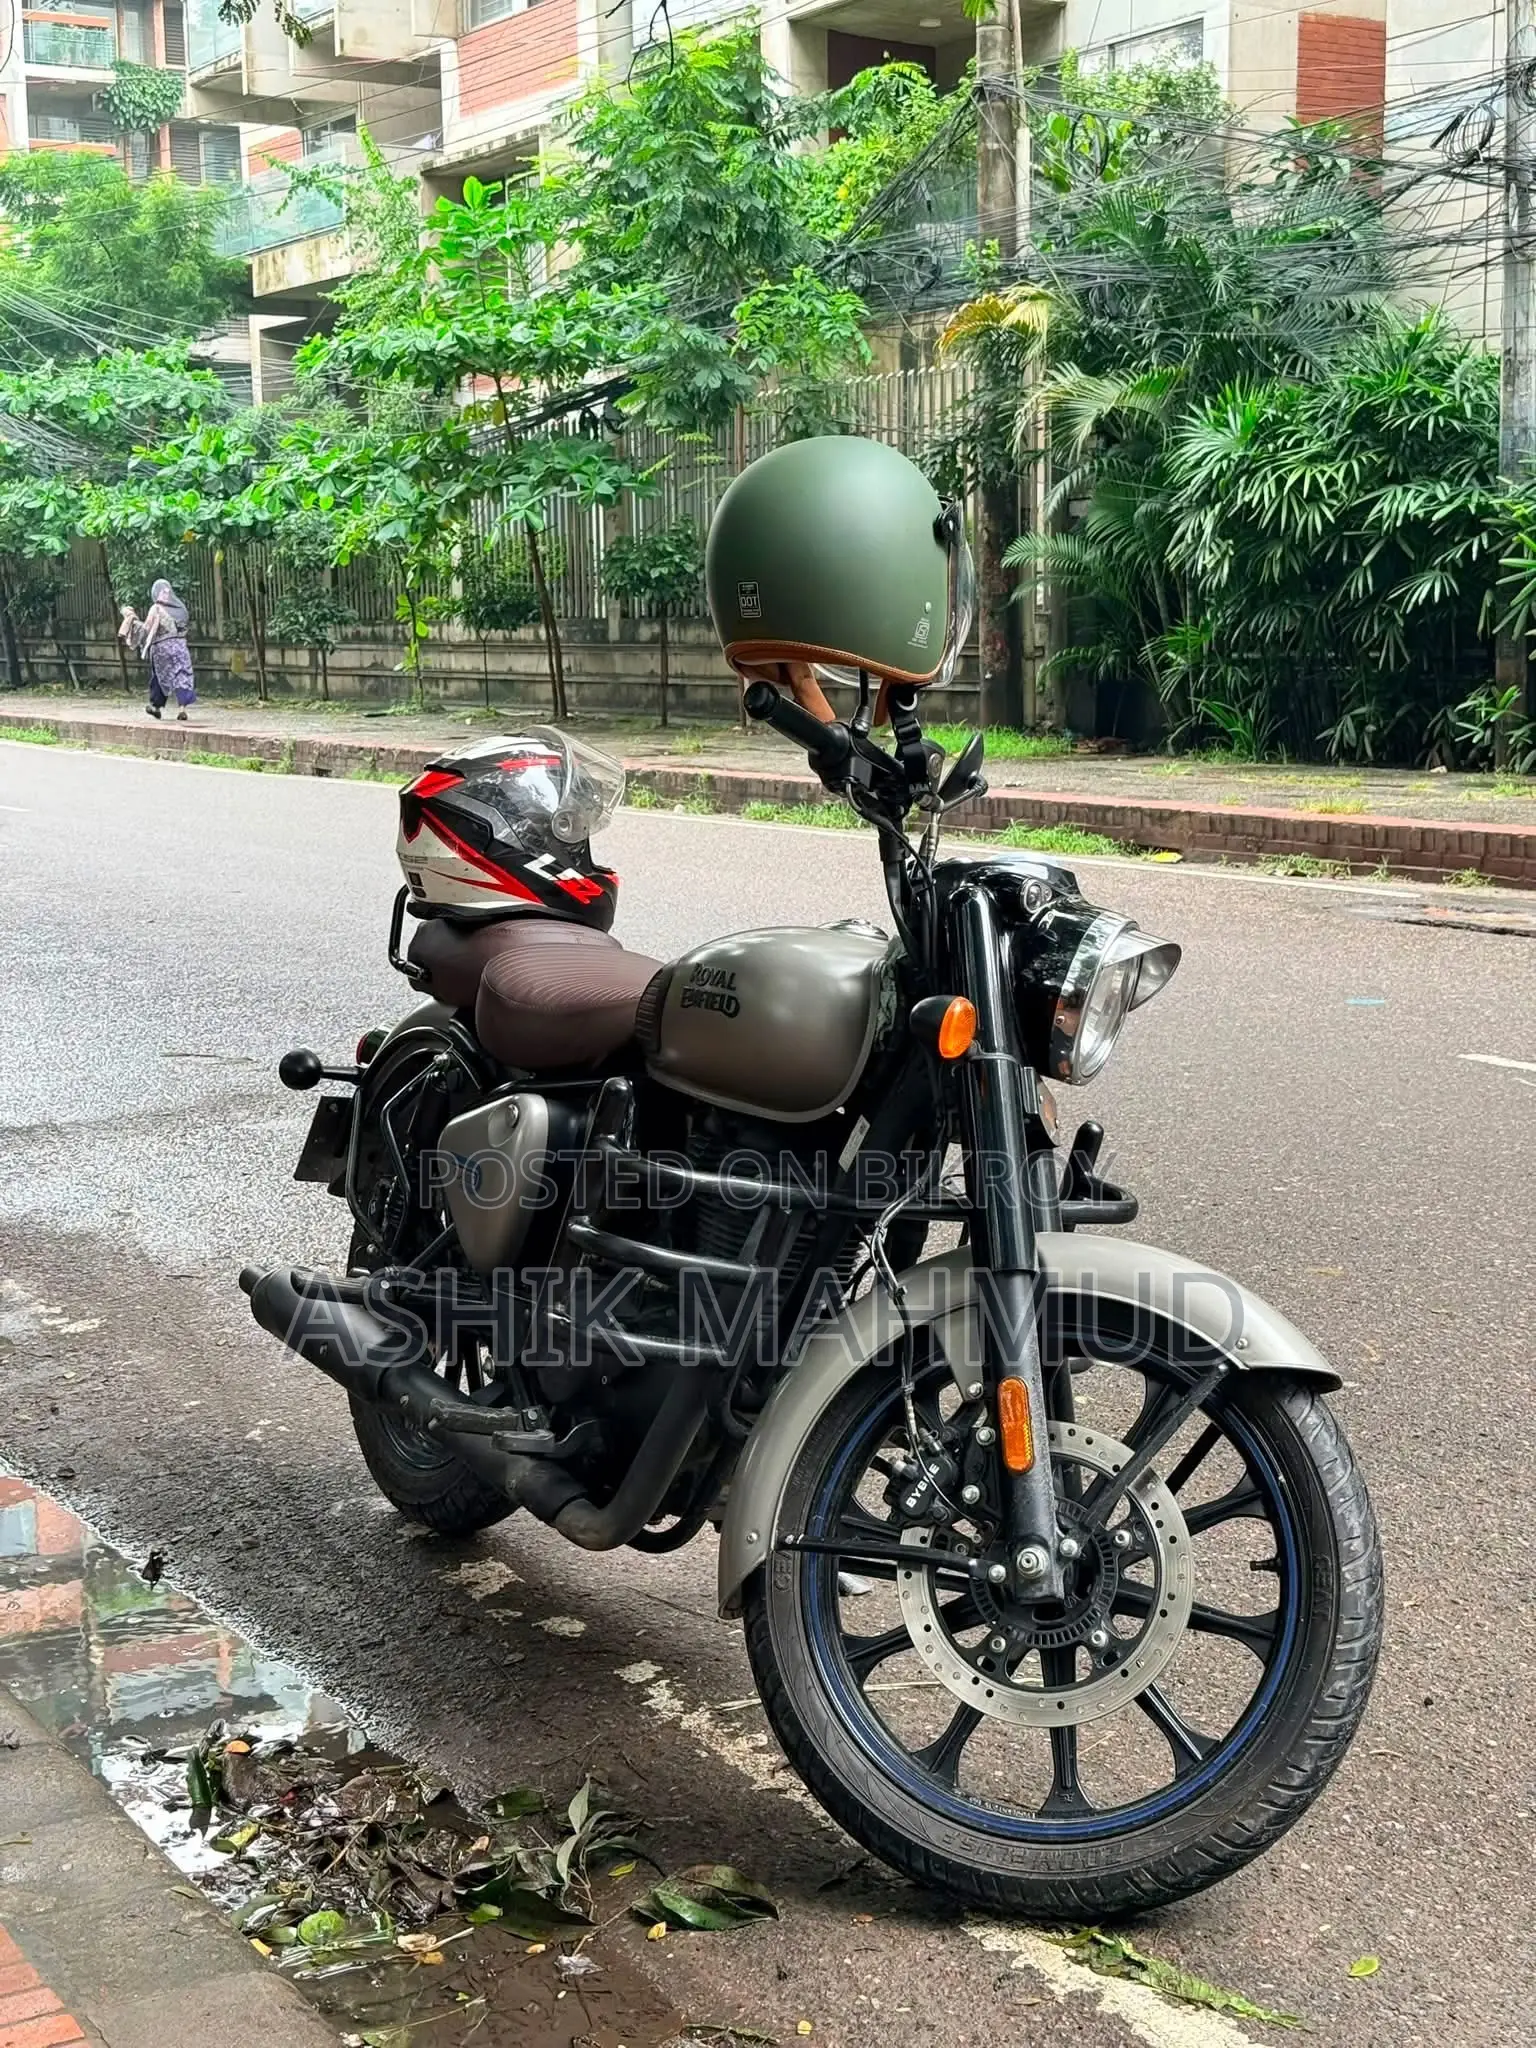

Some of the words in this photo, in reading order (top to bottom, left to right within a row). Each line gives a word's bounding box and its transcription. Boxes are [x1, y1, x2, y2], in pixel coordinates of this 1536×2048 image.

[740, 596, 757, 607] DOT
[690, 962, 737, 991] ROYAL
[680, 985, 741, 1018] ENFIELD
